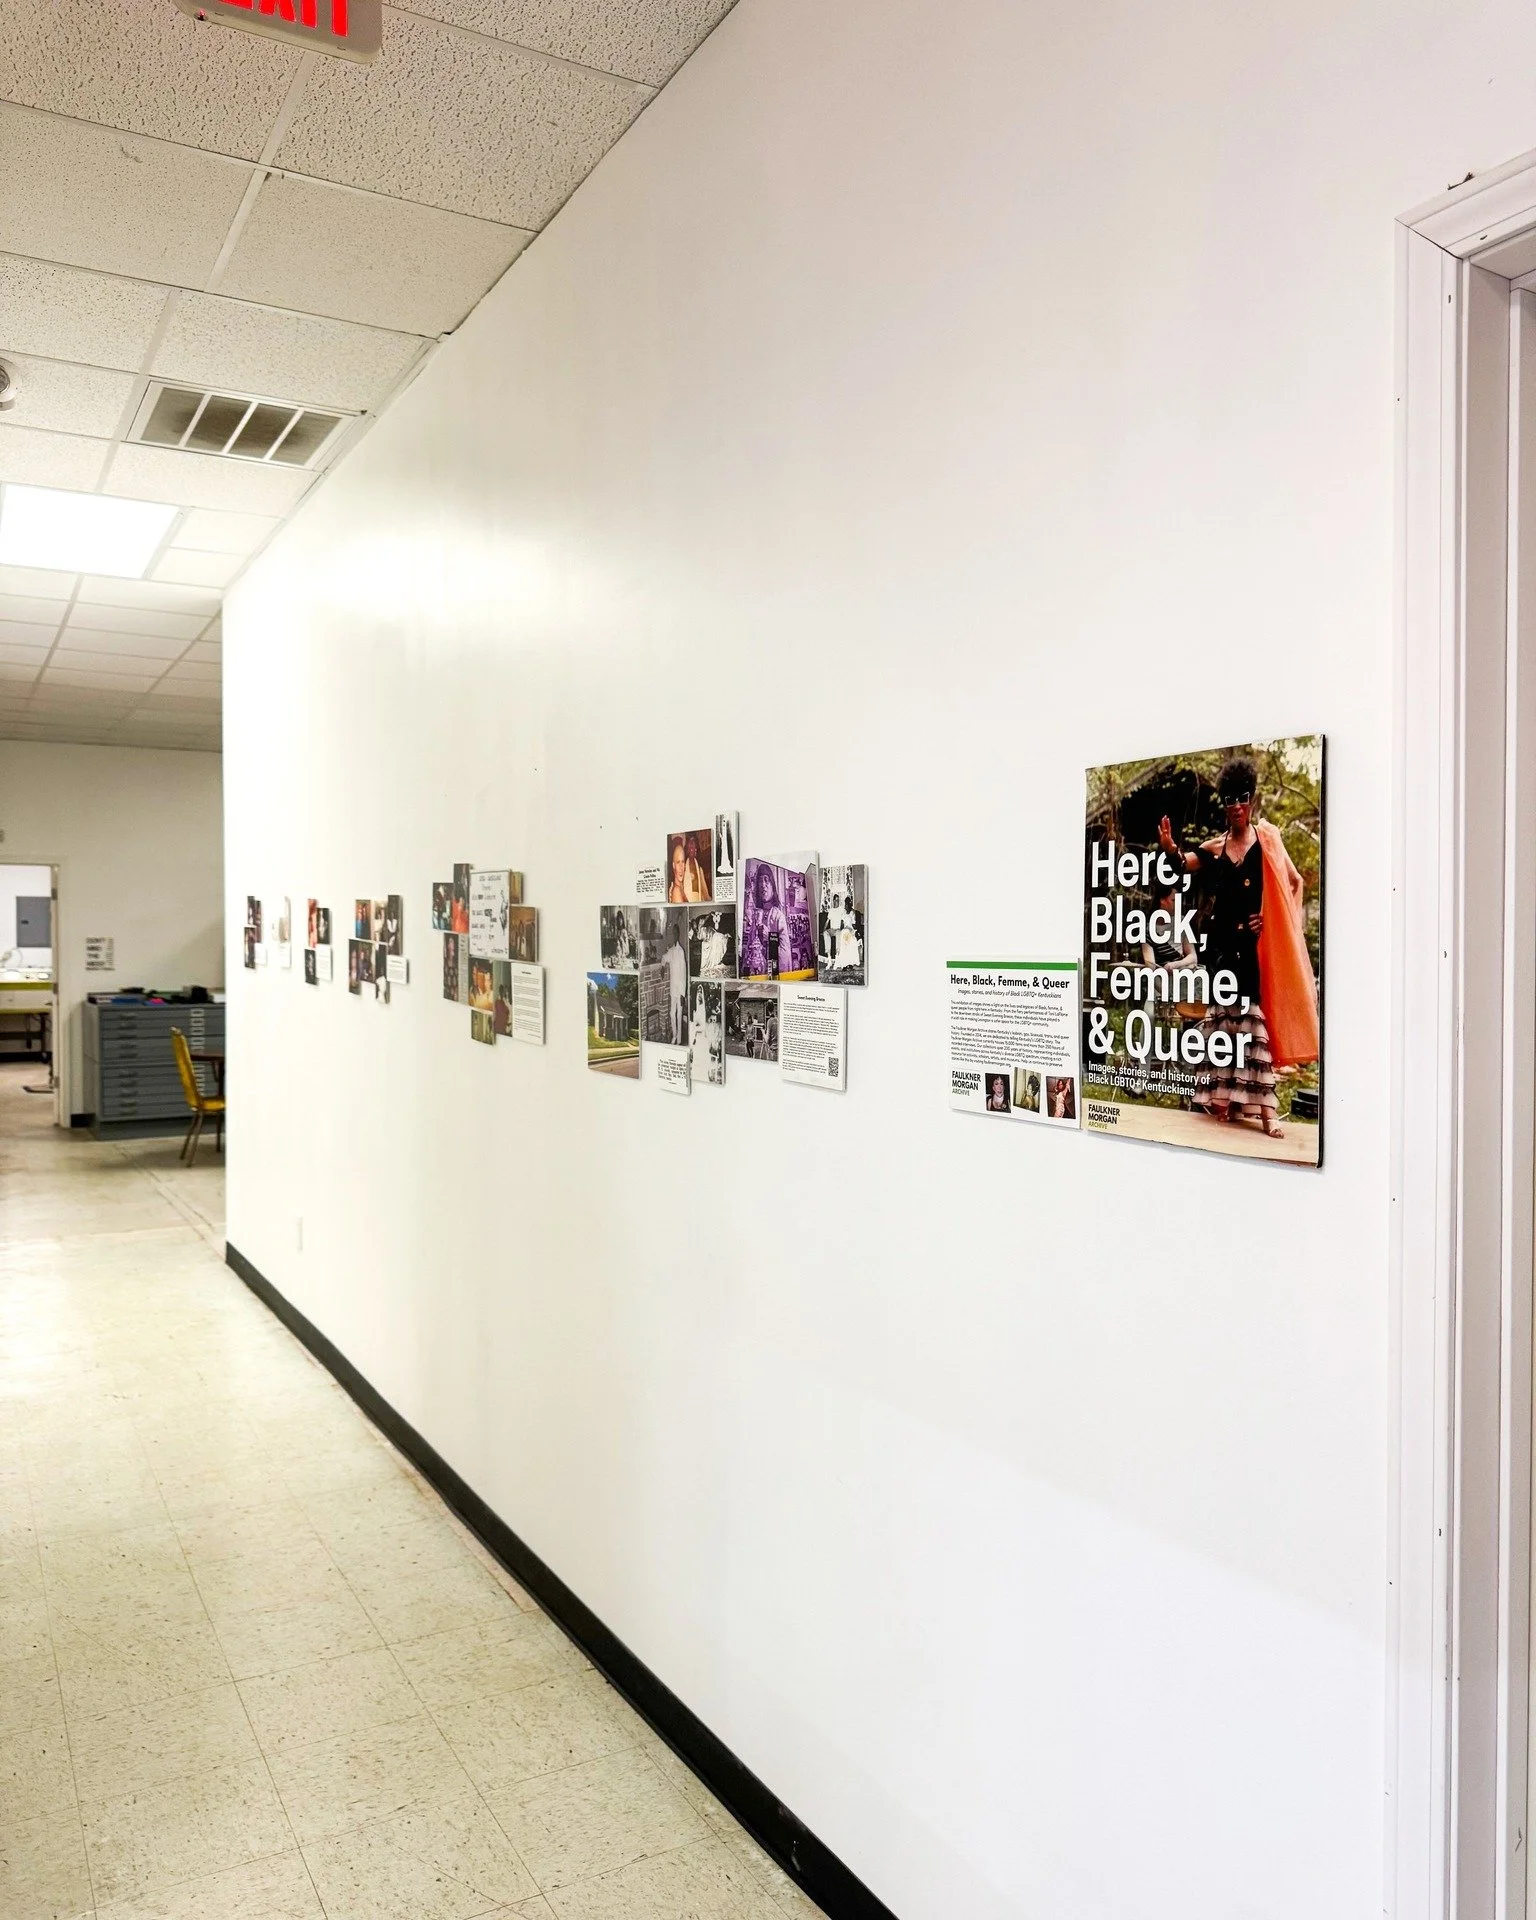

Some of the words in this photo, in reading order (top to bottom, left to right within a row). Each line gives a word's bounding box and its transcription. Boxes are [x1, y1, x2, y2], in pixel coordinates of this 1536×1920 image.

[1092, 840, 1191, 892] Here,
[1090, 892, 1208, 951] Black,
[951, 974, 970, 986] Here,
[972, 975, 996, 987] Black,
[998, 976, 1030, 989] Femme,
[1033, 977, 1040, 987] &
[1042, 977, 1070, 990] Queer
[1090, 952, 1251, 1015] Femme,
[1088, 1006, 1114, 1055] &
[1125, 1009, 1253, 1069] Queer
[952, 1070, 981, 1082] FAULKNER
[1088, 1060, 1117, 1075] Images,
[1119, 1066, 1149, 1079] stories,
[1151, 1069, 1167, 1080] and
[1168, 1070, 1199, 1086] history
[1201, 1074, 1210, 1085] of
[952, 1080, 978, 1090] MORGAN
[1088, 1073, 1109, 1085] Black
[1110, 1075, 1141, 1089] LGBTQ+
[1142, 1080, 1195, 1097] Kentuckians
[1088, 1104, 1120, 1116] FAULKNER
[1088, 1112, 1117, 1124] MORGAN
[1088, 1121, 1108, 1129] ARCHIVE
